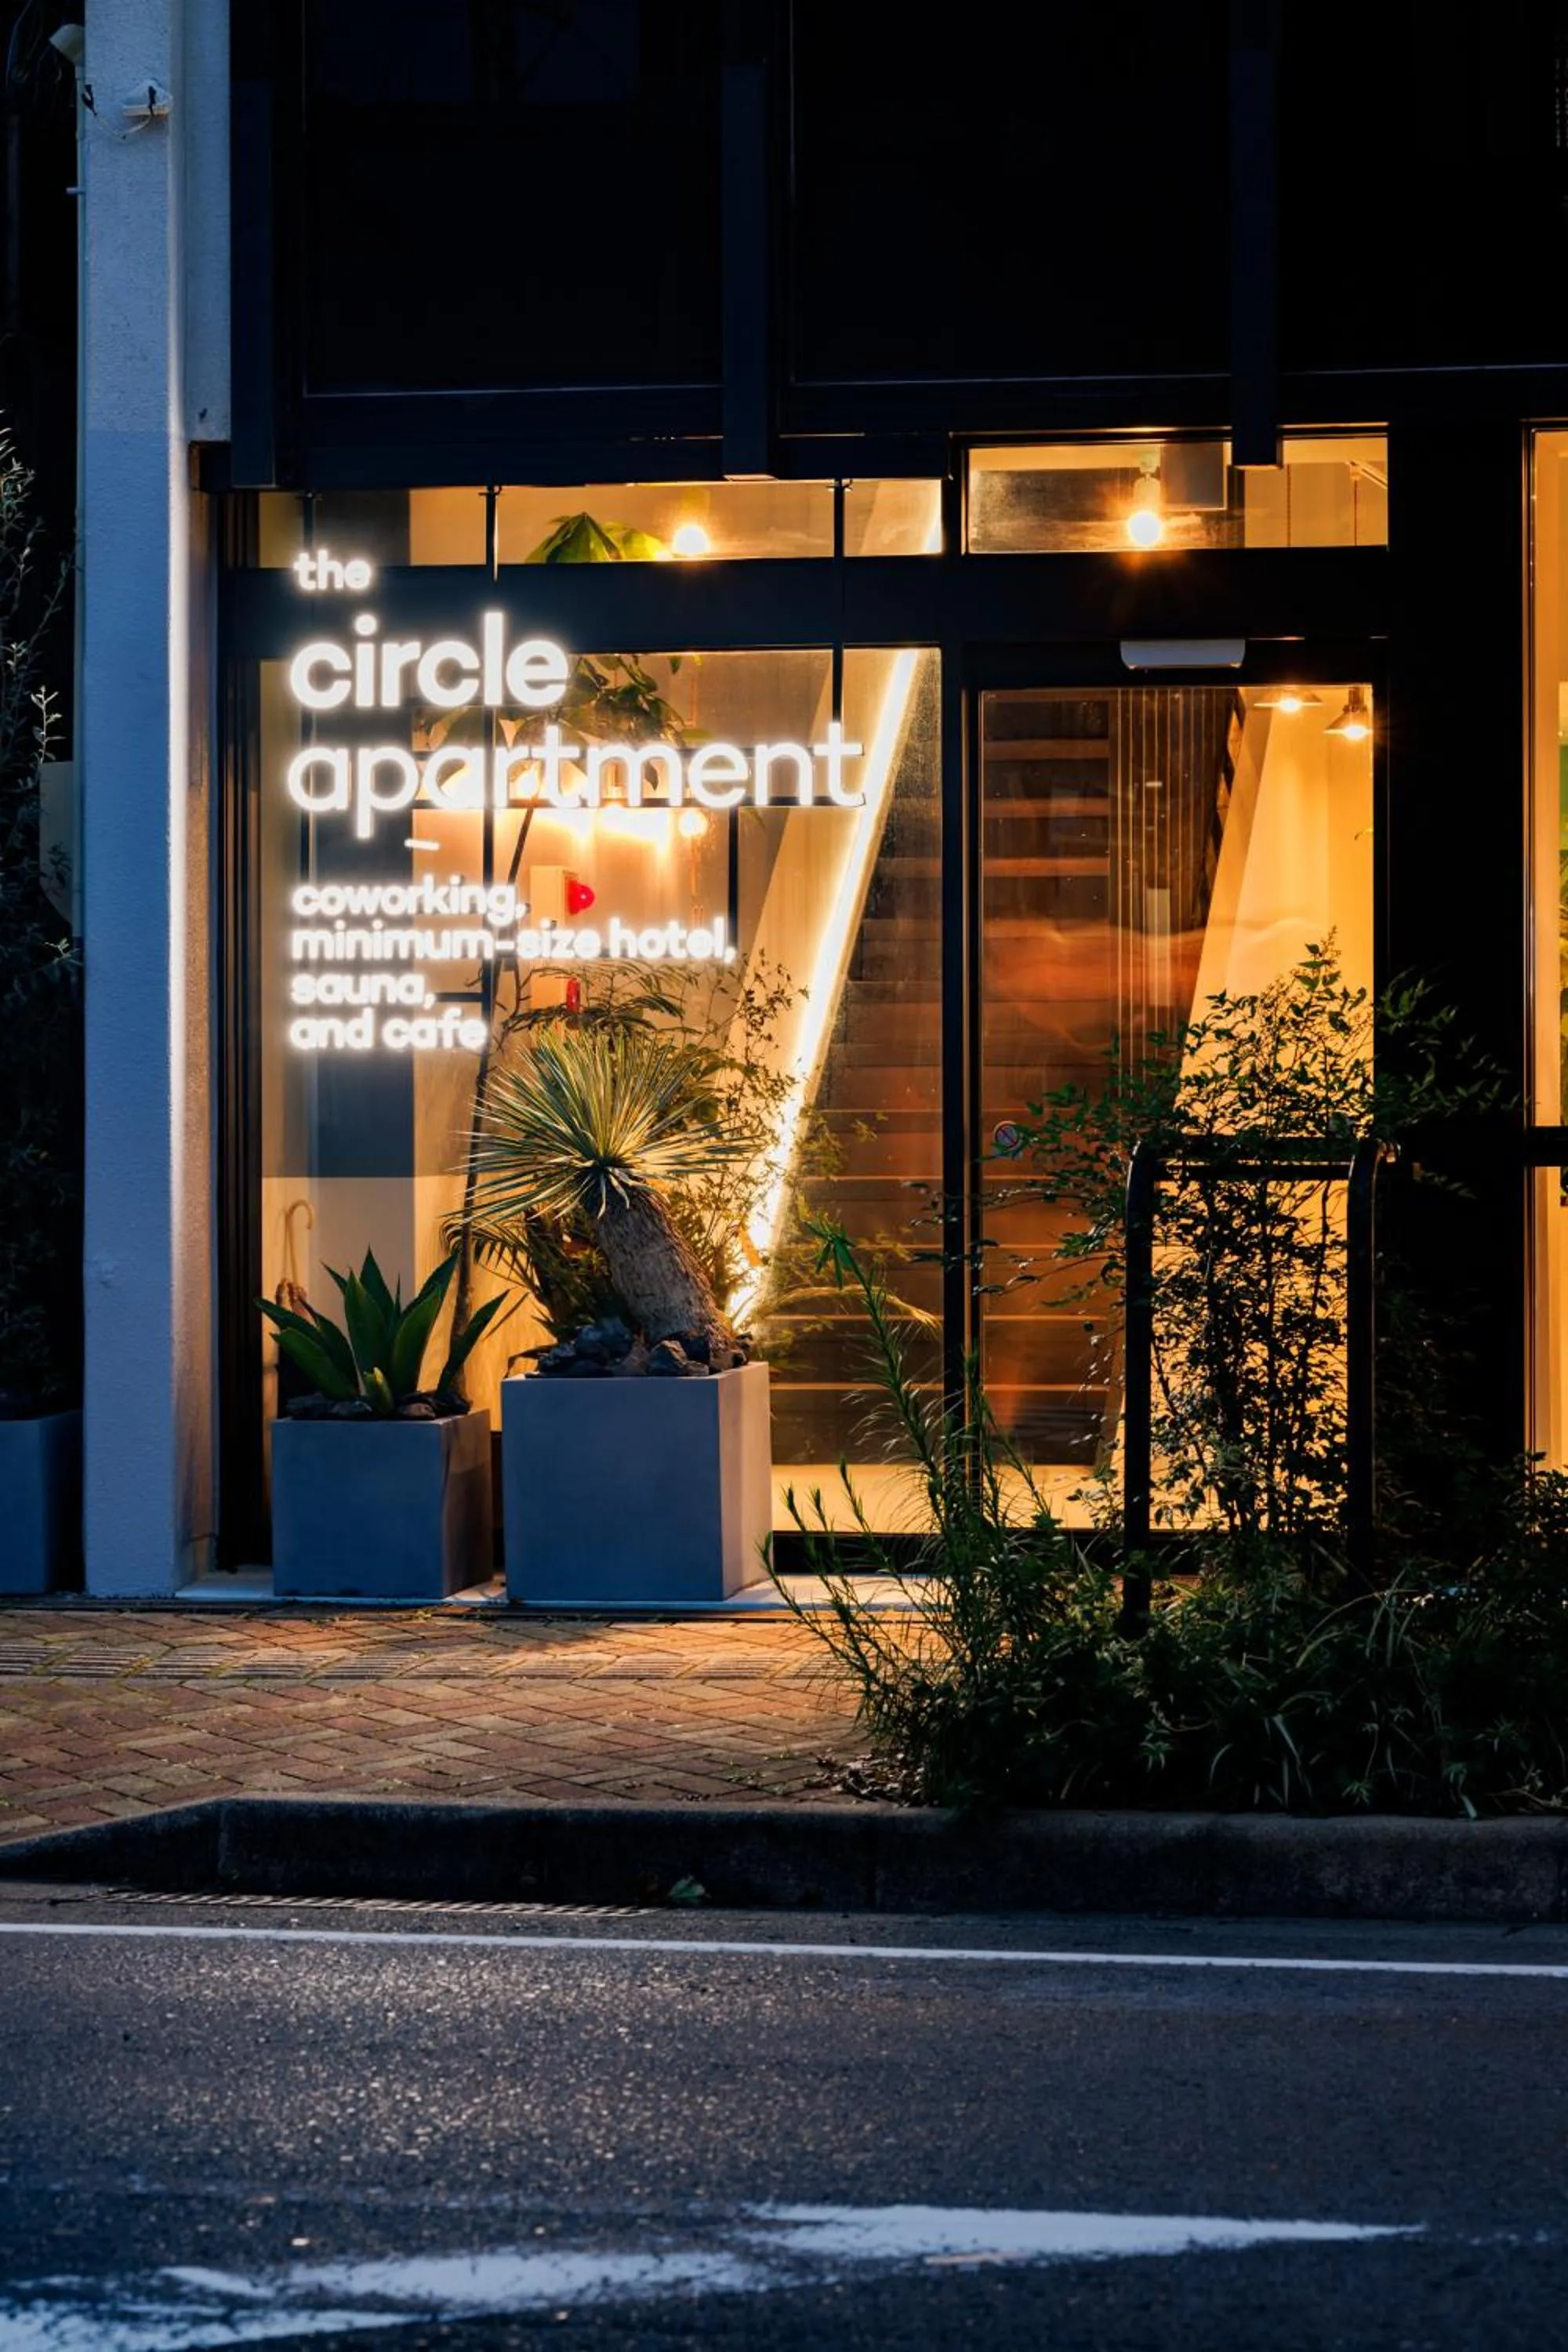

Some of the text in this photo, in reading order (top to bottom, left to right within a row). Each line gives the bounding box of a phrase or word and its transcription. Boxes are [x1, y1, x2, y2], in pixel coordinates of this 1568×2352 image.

[295, 550, 372, 590] the
[289, 612, 569, 708] circle
[288, 721, 865, 838] apartment
[292, 875, 527, 926] coworking,
[292, 916, 736, 964] minimum-size hotel,
[291, 973, 435, 1009] sauna,
[291, 1008, 487, 1050] and cafe
